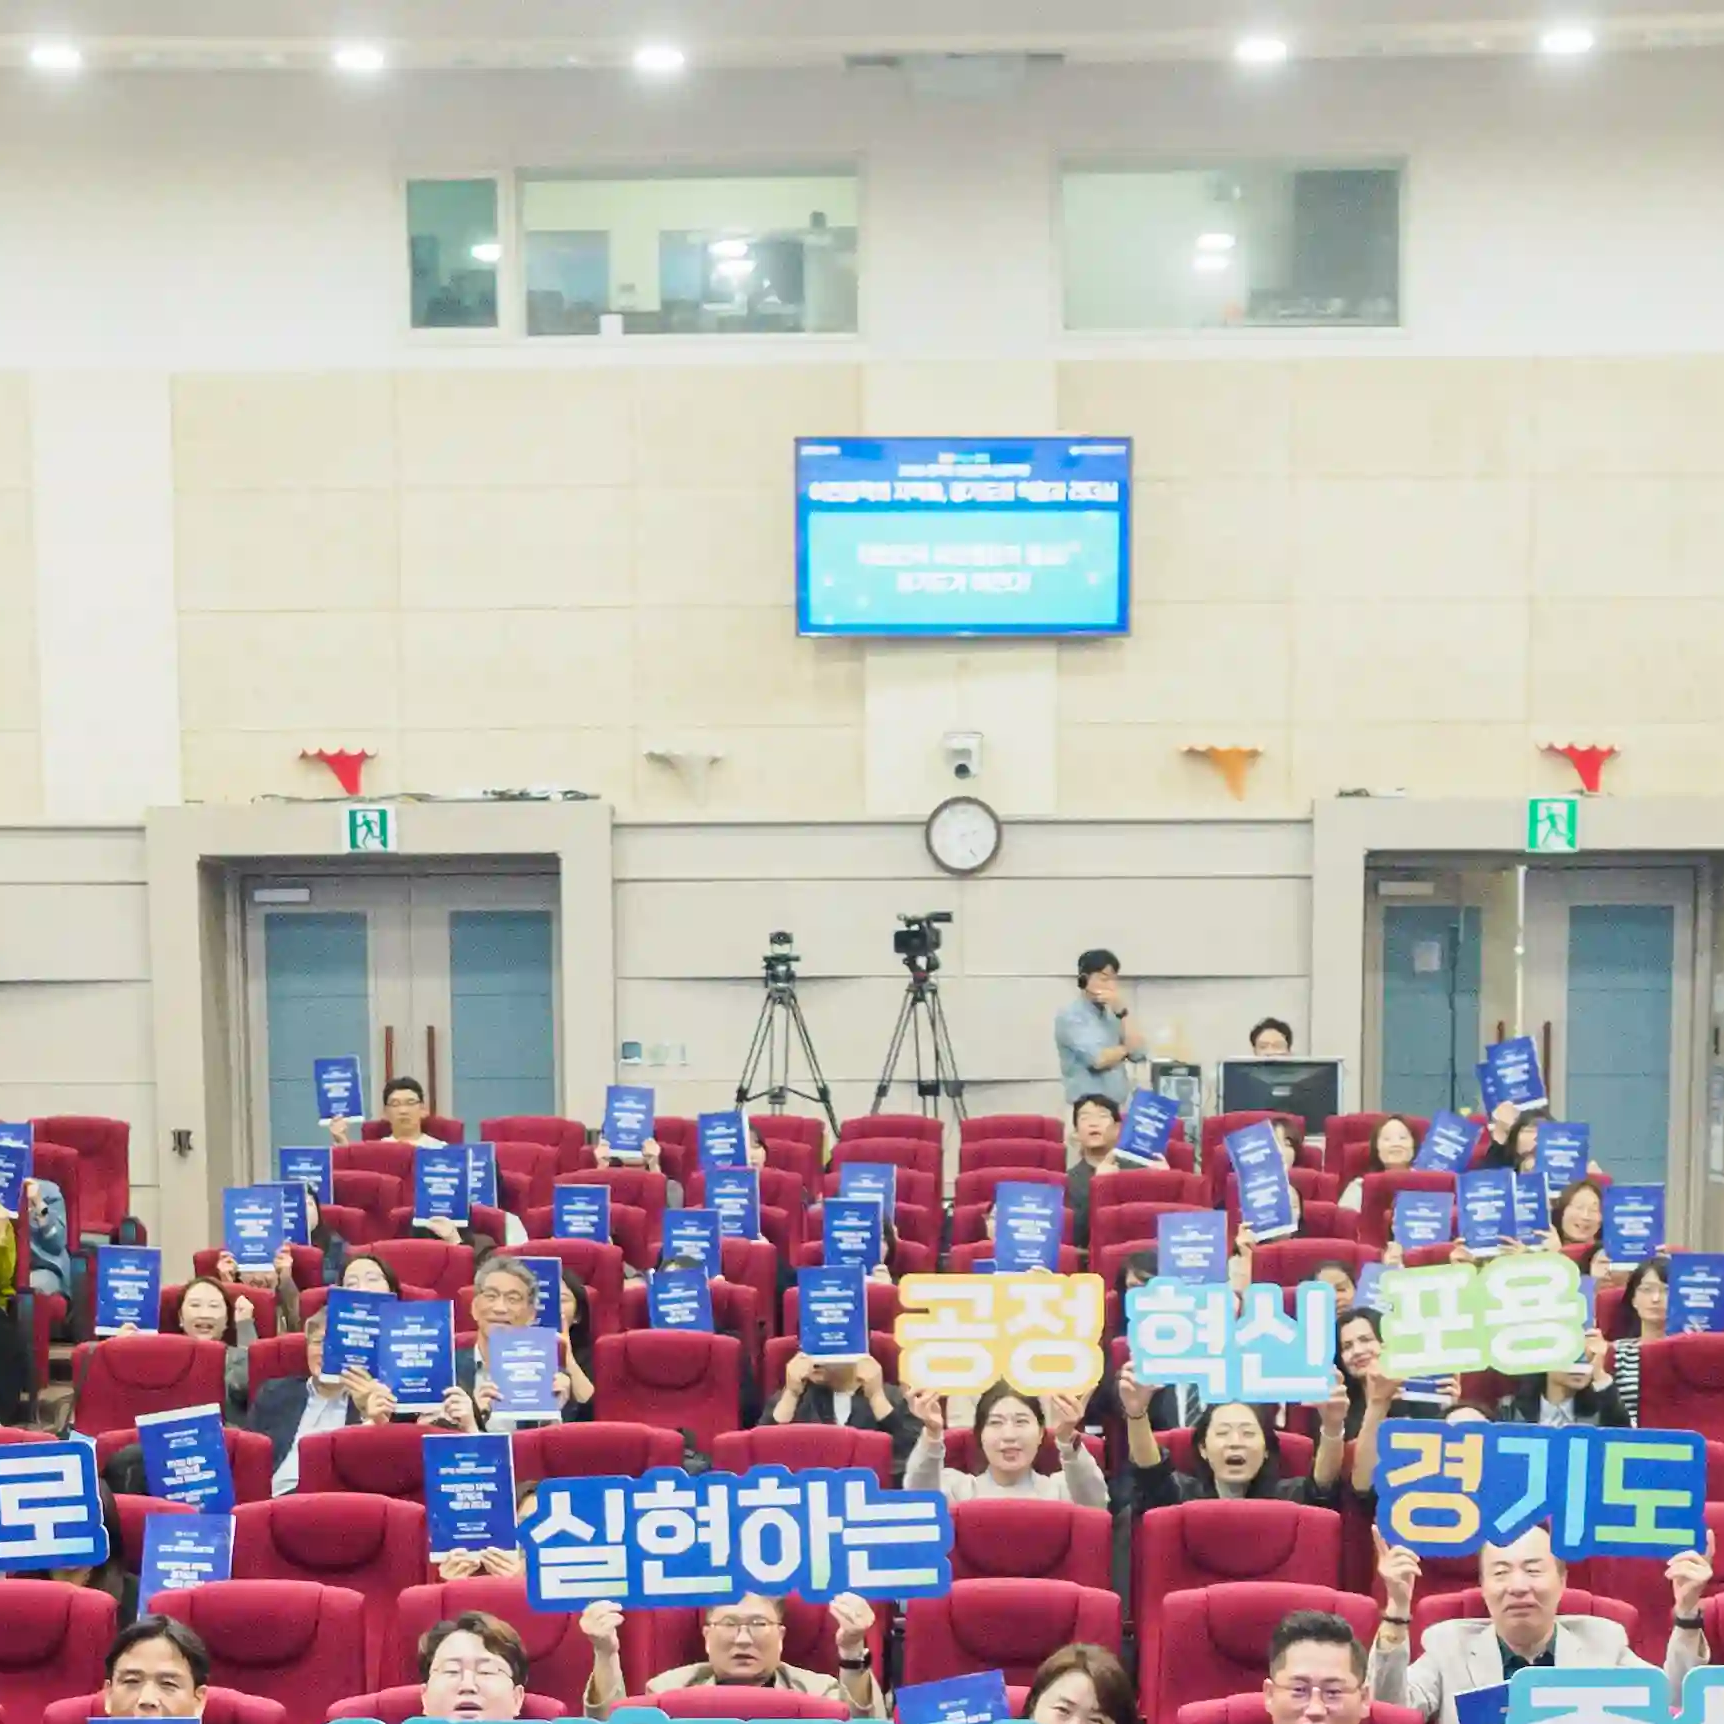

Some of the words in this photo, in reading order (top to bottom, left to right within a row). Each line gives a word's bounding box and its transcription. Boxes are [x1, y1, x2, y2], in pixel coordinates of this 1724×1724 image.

[902, 1281, 1099, 1388] 공정
[1135, 1285, 1329, 1397] 혁신
[1389, 1262, 1578, 1368] 포용
[530, 1478, 940, 1599] 실현하는
[1389, 1434, 1694, 1546] 경기도
